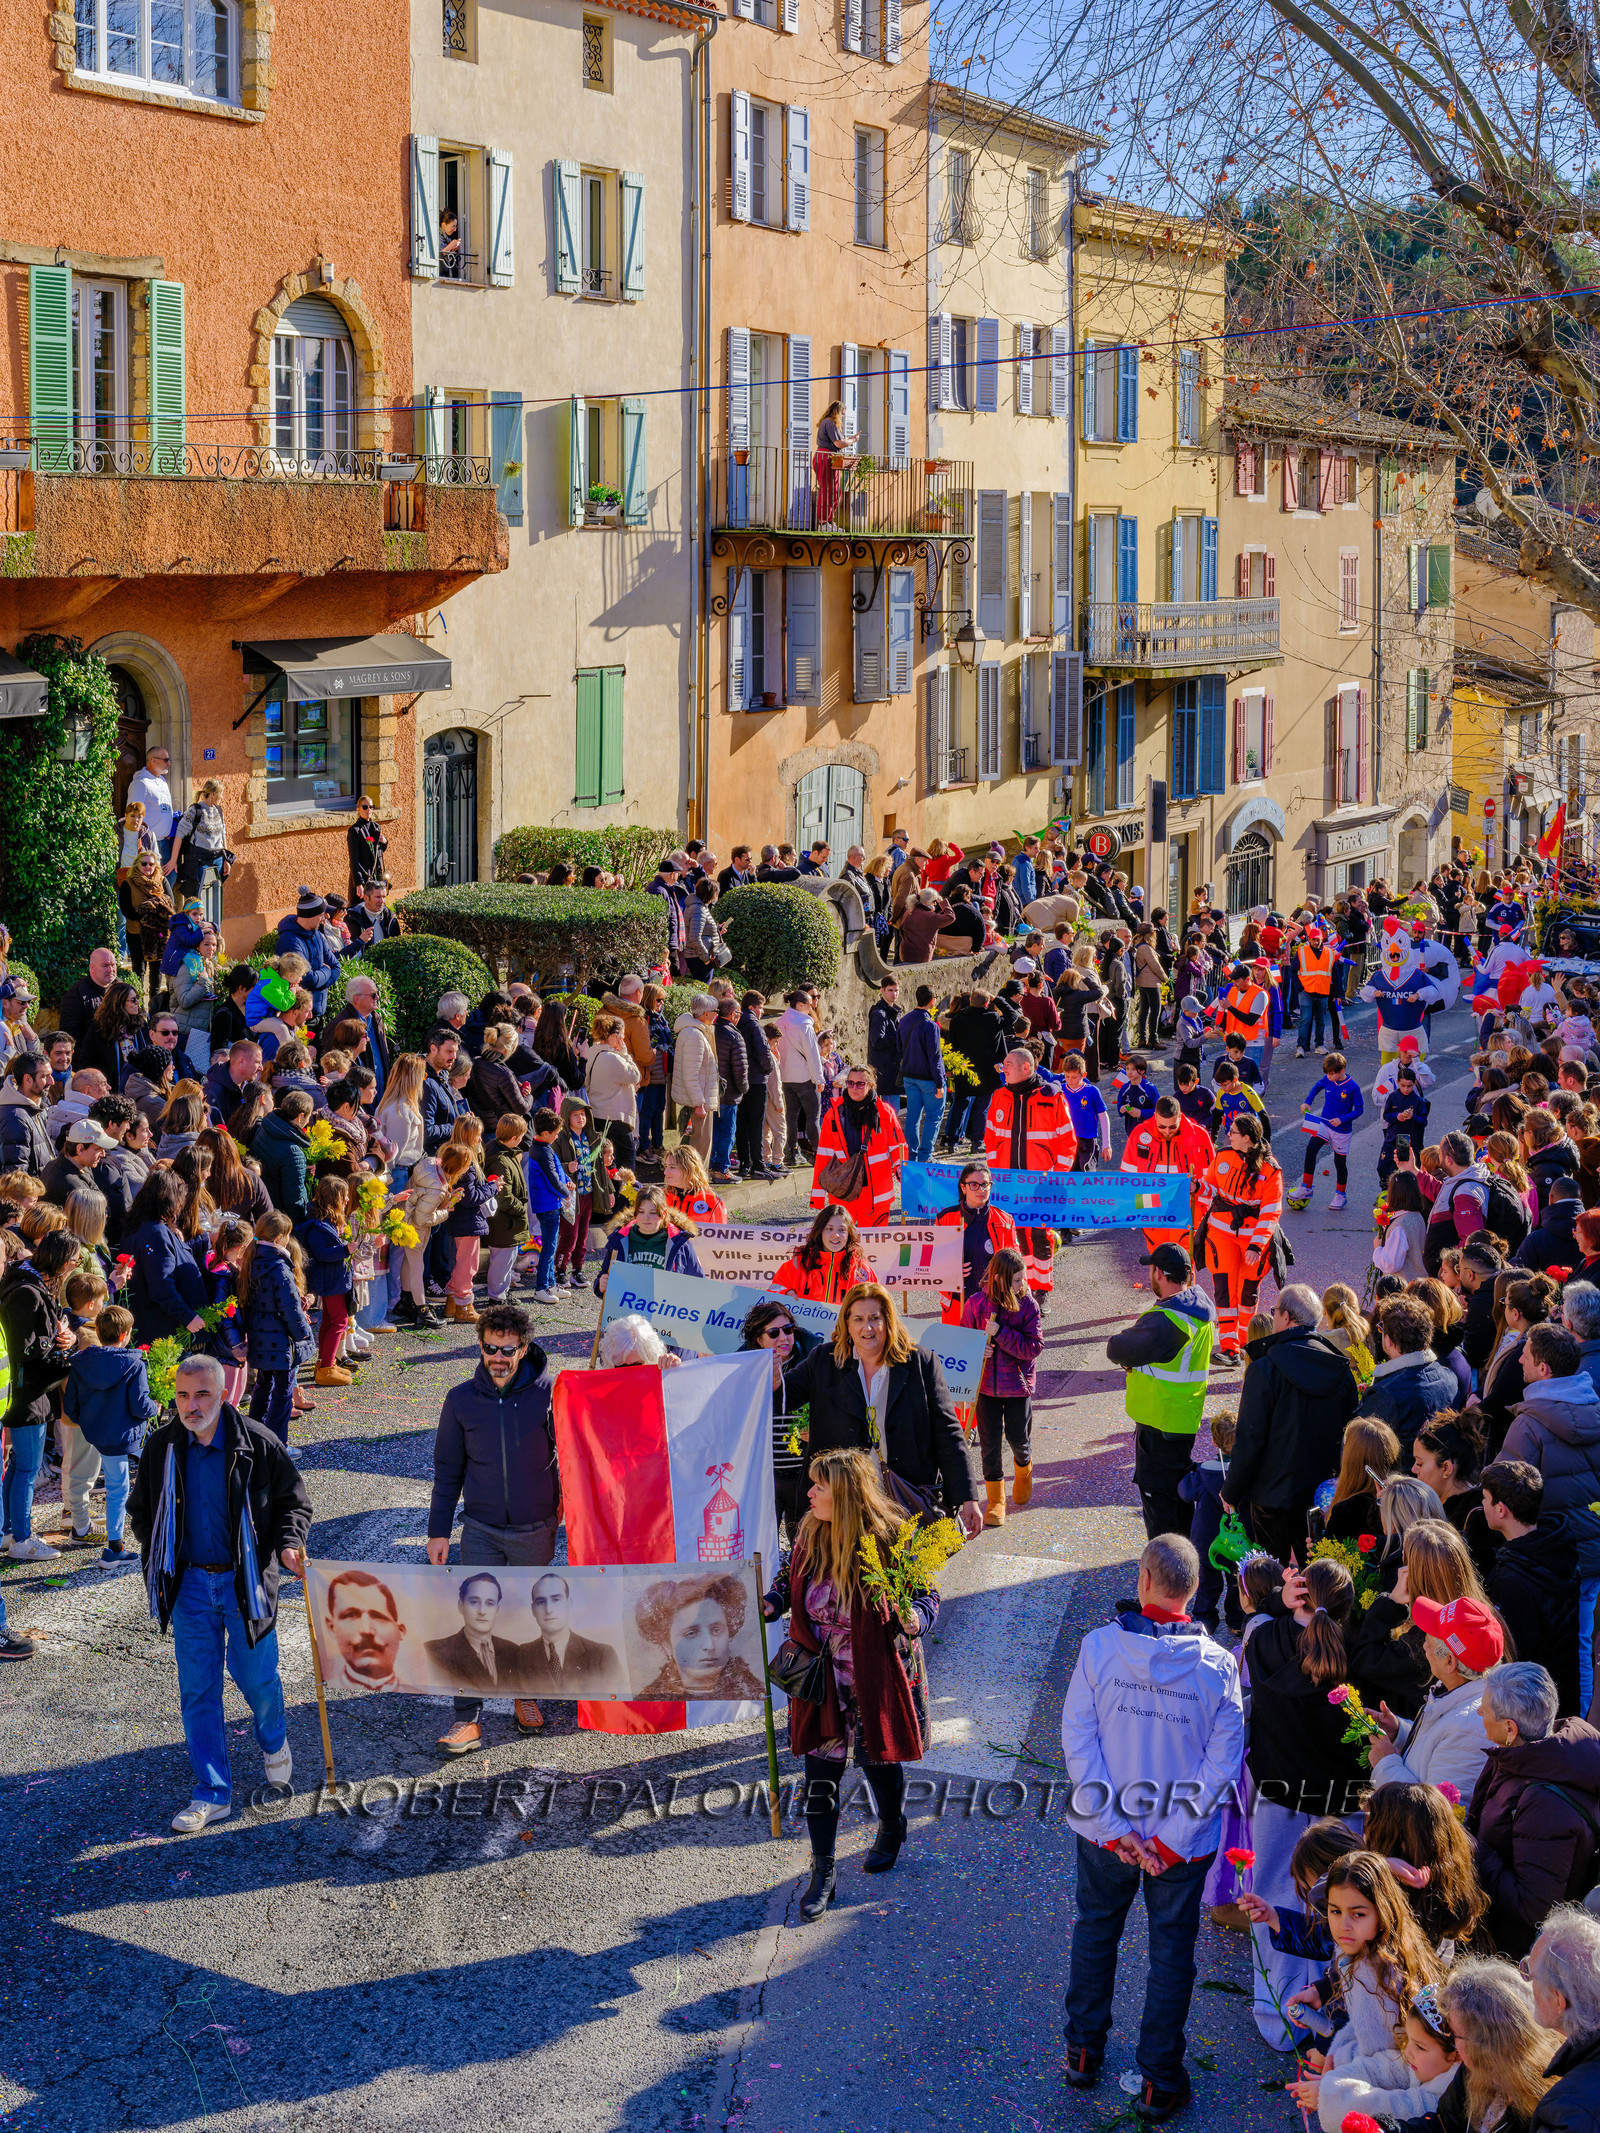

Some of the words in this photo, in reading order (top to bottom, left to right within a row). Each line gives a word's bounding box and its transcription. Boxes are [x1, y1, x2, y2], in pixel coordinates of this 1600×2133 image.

[349, 672, 381, 684] MAGREY
[383, 672, 389, 682] &
[391, 671, 410, 681] SONS
[1089, 827, 1112, 837] BARNES
[1095, 836, 1107, 853] B
[1017, 1175, 1077, 1186] SOPHIA
[1082, 1176, 1167, 1187] ANTIPOLIS
[1013, 1193, 1077, 1205] jumelée
[1081, 1197, 1115, 1206] avec
[1072, 1214, 1085, 1223] in
[1091, 1214, 1120, 1224] VAL
[1125, 1214, 1177, 1223] D'arno
[712, 1250, 752, 1260] Ville
[885, 1275, 943, 1286] D'arno
[619, 1291, 701, 1323] Racines
[1114, 1678, 1148, 1692] Réserve
[1149, 1684, 1201, 1702] Communale
[1117, 1703, 1128, 1713] de
[1130, 1705, 1164, 1720] Sécurité
[1165, 1713, 1191, 1724] Civile
